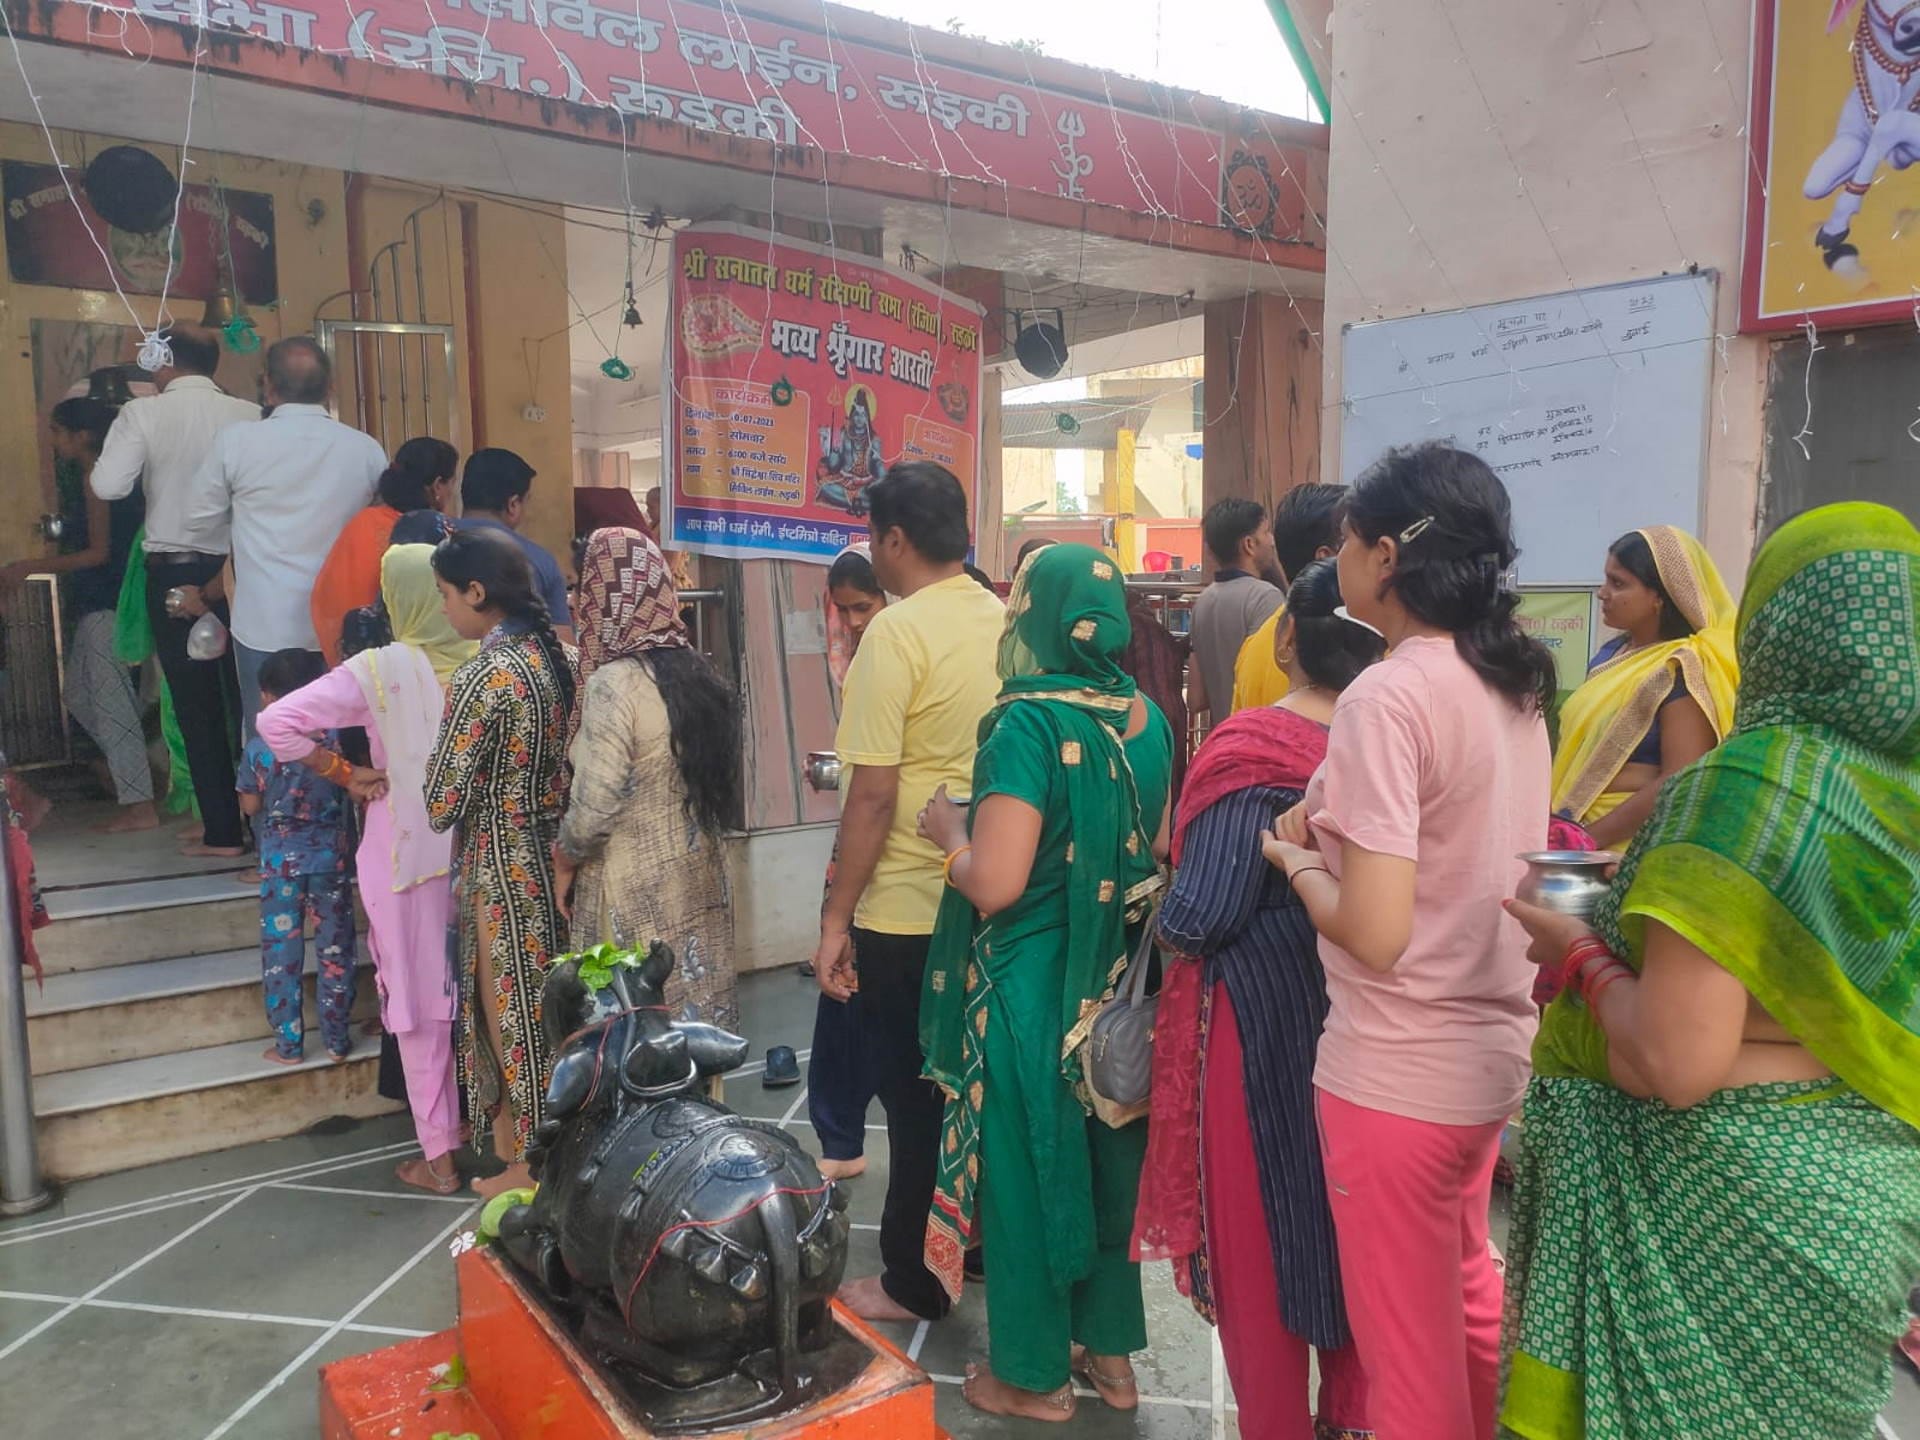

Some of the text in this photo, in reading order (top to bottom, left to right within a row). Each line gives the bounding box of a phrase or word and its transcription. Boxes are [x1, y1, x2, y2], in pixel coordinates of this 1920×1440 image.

[682, 249, 710, 279] श्री
[713, 254, 778, 290] सनातन
[784, 266, 813, 298] धर्म
[877, 291, 904, 322] सभा
[771, 320, 820, 359] भव्य
[890, 345, 934, 390] आरती
[703, 517, 726, 534] सभी
[729, 519, 748, 535] धर्म
[820, 529, 848, 545] सहित
